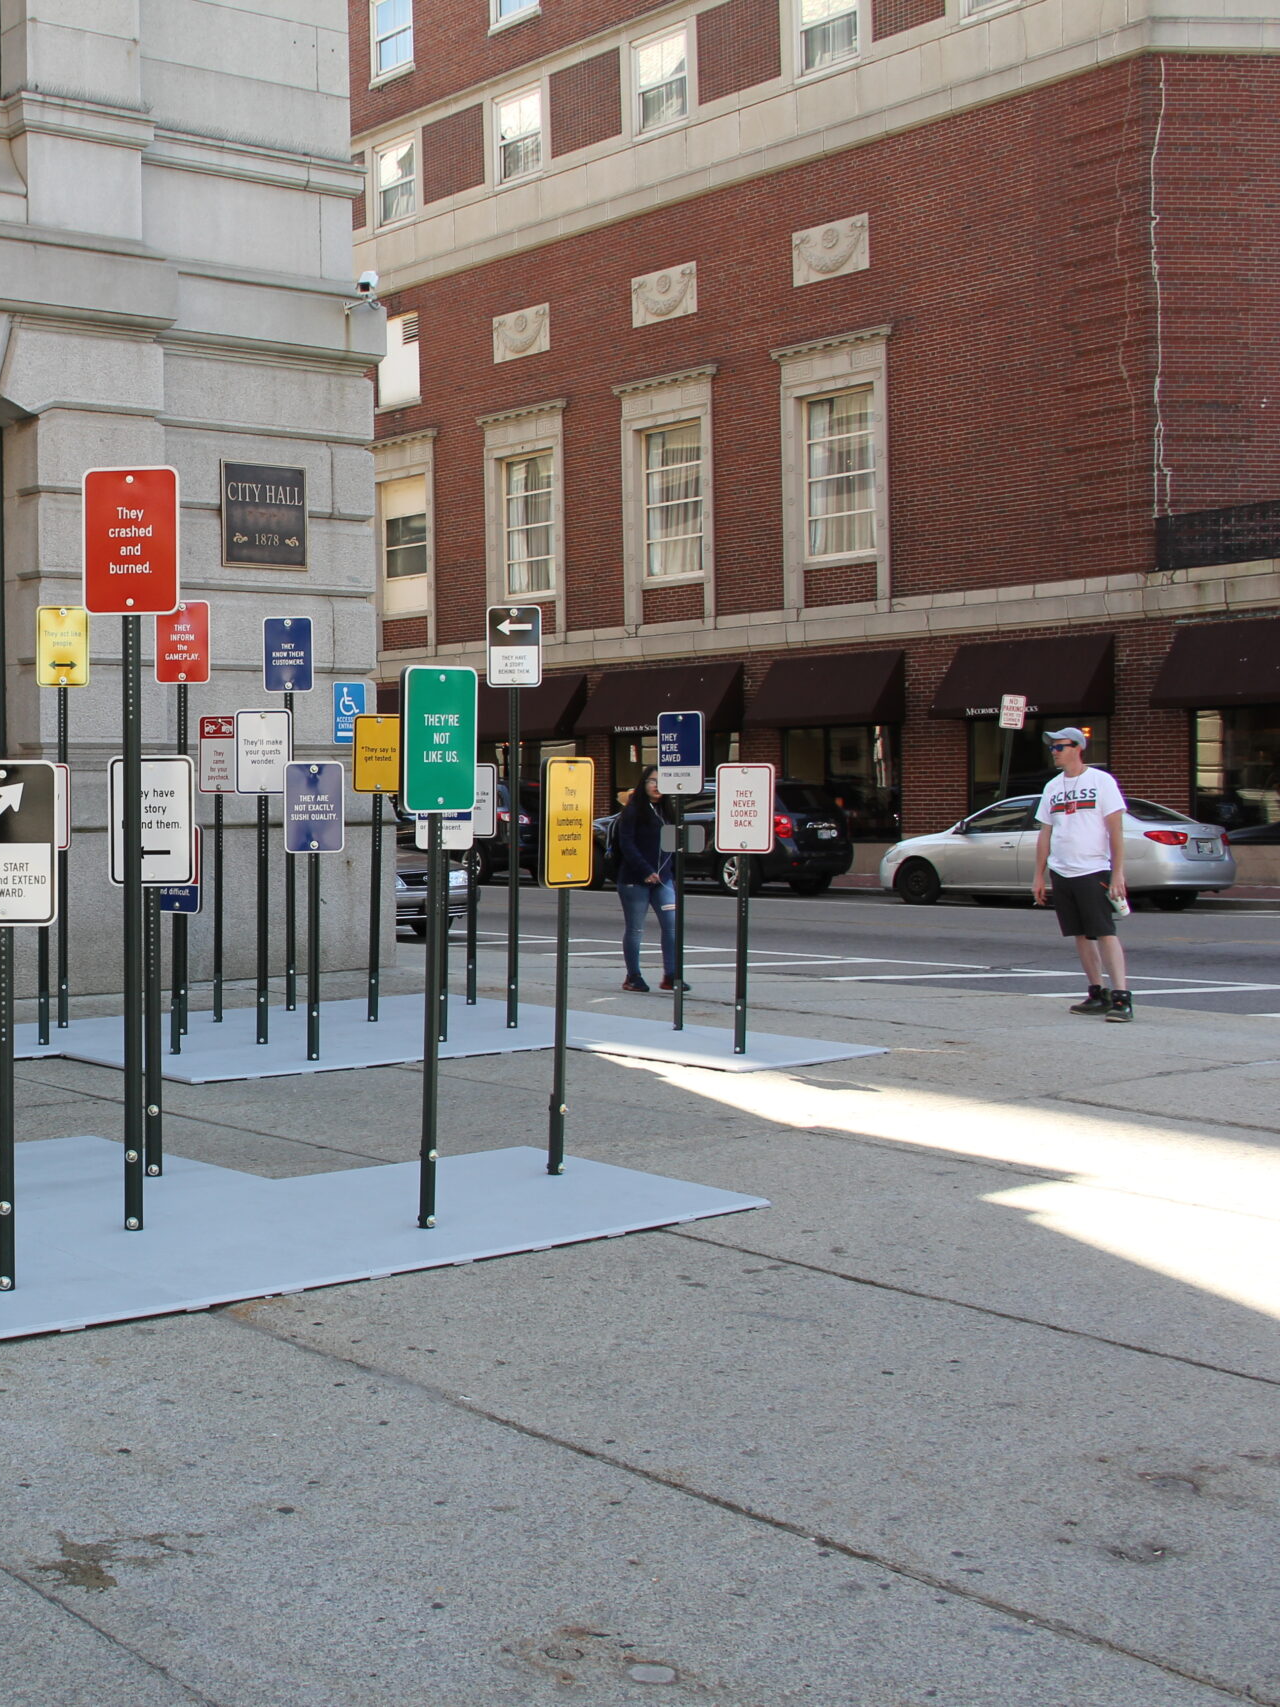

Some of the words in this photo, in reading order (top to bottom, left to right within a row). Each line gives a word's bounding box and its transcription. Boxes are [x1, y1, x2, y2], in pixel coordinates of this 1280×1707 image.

[227, 482, 261, 503] CITY
[266, 484, 303, 506] HALL
[116, 507, 144, 522] They
[108, 525, 153, 538] crashed
[255, 533, 280, 546] 1878
[119, 543, 141, 556] and
[109, 561, 153, 575] burned.
[173, 624, 191, 632] THEY
[44, 630, 58, 639] They
[170, 633, 195, 641] INFORM
[164, 653, 201, 661] GAMEPLAY.
[272, 658, 305, 666] CUSTOMERS.
[424, 714, 460, 727] THEY'RE
[433, 732, 450, 745] NOT
[661, 733, 678, 742] THEY
[243, 739, 264, 747] They'll
[661, 743, 679, 752] WERE
[213, 750, 225, 759] They
[245, 749, 260, 757] your
[261, 748, 282, 758] guests
[423, 751, 443, 763] LIKE
[445, 750, 460, 763] US.
[364, 755, 374, 763] get
[661, 753, 681, 763] SAVED
[152, 788, 175, 798] have
[564, 786, 577, 799] They
[735, 789, 754, 798] THEY
[1049, 788, 1097, 806] RCKLSS
[316, 794, 329, 802] ARE
[294, 804, 307, 812] NOT
[308, 803, 335, 812] EXACTLY
[561, 801, 574, 811] form
[732, 799, 756, 808] NEVER
[144, 803, 167, 816] story
[730, 809, 758, 818] LOOKED
[290, 813, 310, 821] SUSHI
[311, 813, 339, 821] QUALITY.
[156, 819, 182, 829] them.
[734, 819, 755, 828] BACK.
[558, 832, 582, 841] uncertain
[3, 861, 30, 872] START
[12, 875, 47, 885] EXTEND
[160, 887, 168, 895] nd
